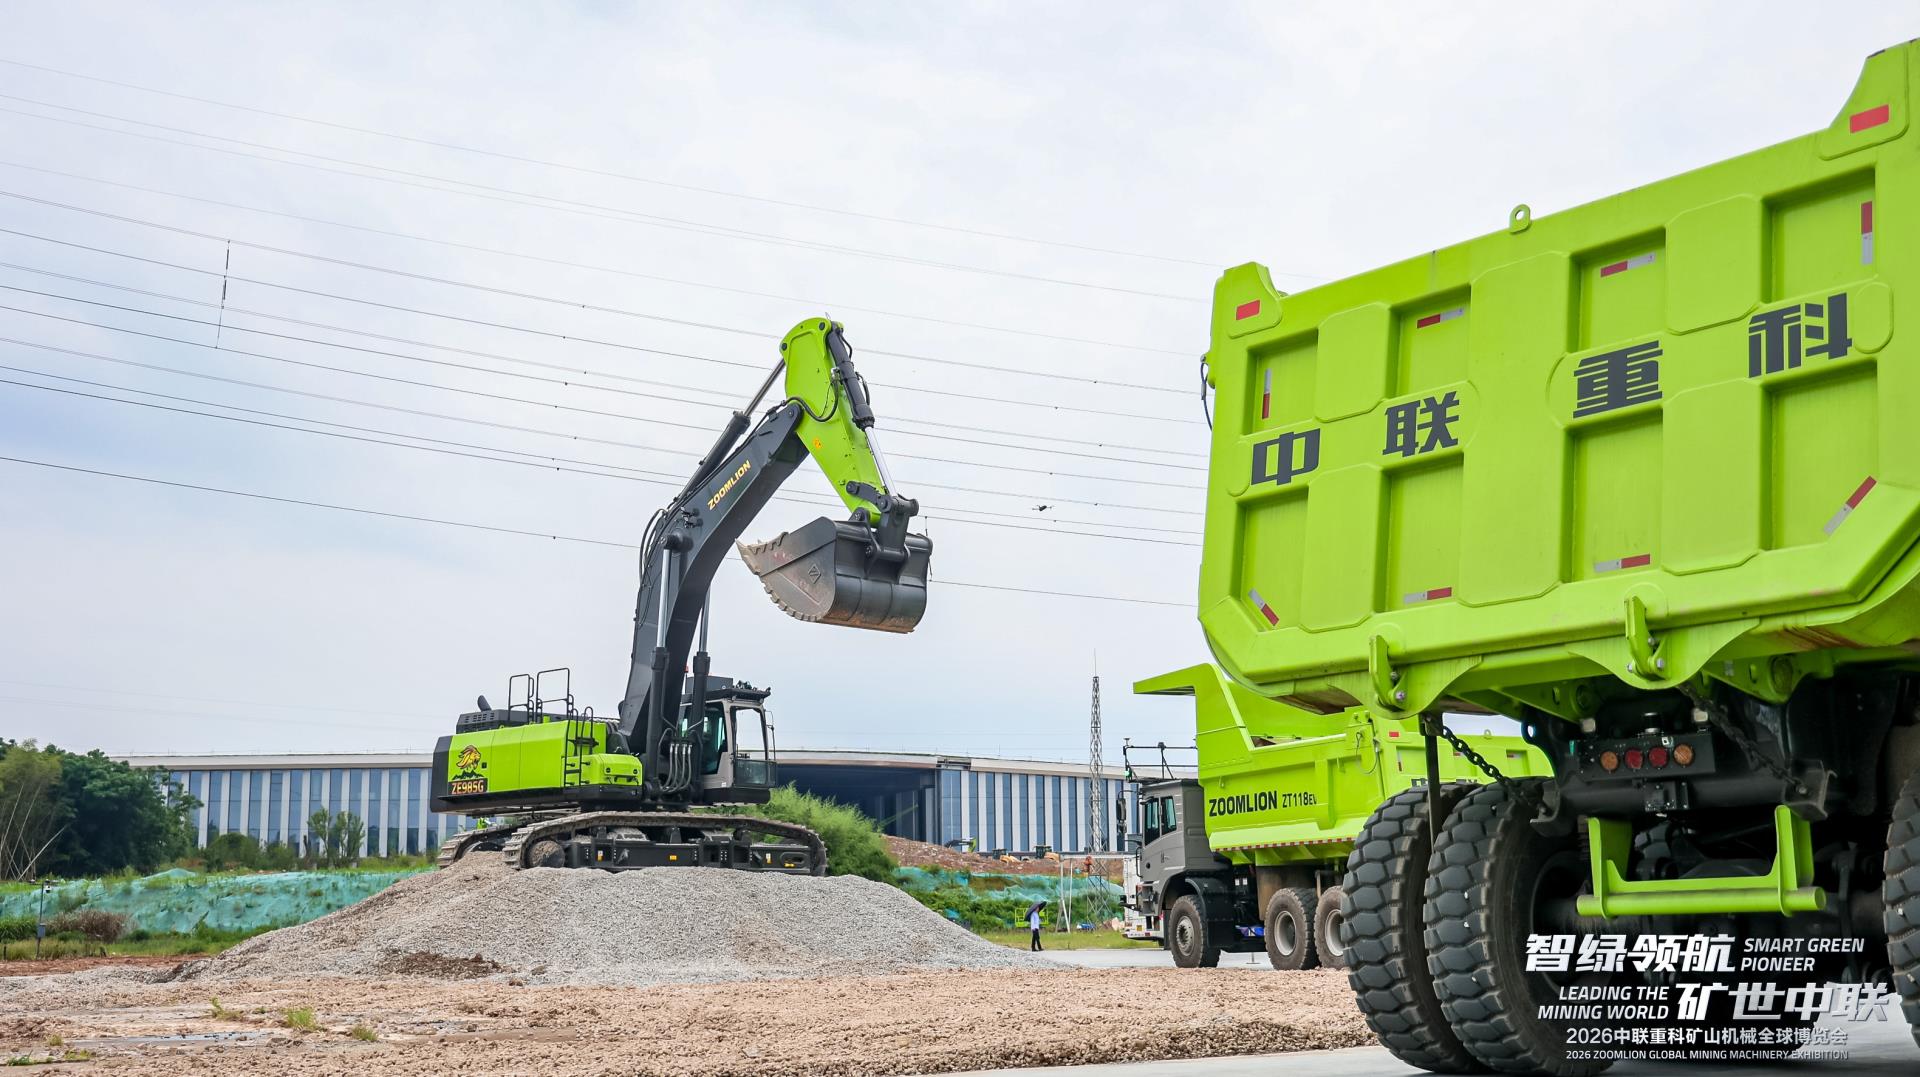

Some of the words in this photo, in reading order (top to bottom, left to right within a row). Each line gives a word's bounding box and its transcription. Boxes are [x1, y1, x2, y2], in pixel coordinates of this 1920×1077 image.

[1251, 293, 1852, 486] 中联重科
[707, 459, 752, 511] ZOOMLION
[451, 780, 484, 795] ZE985G
[1208, 790, 1278, 817] ZOOMLION
